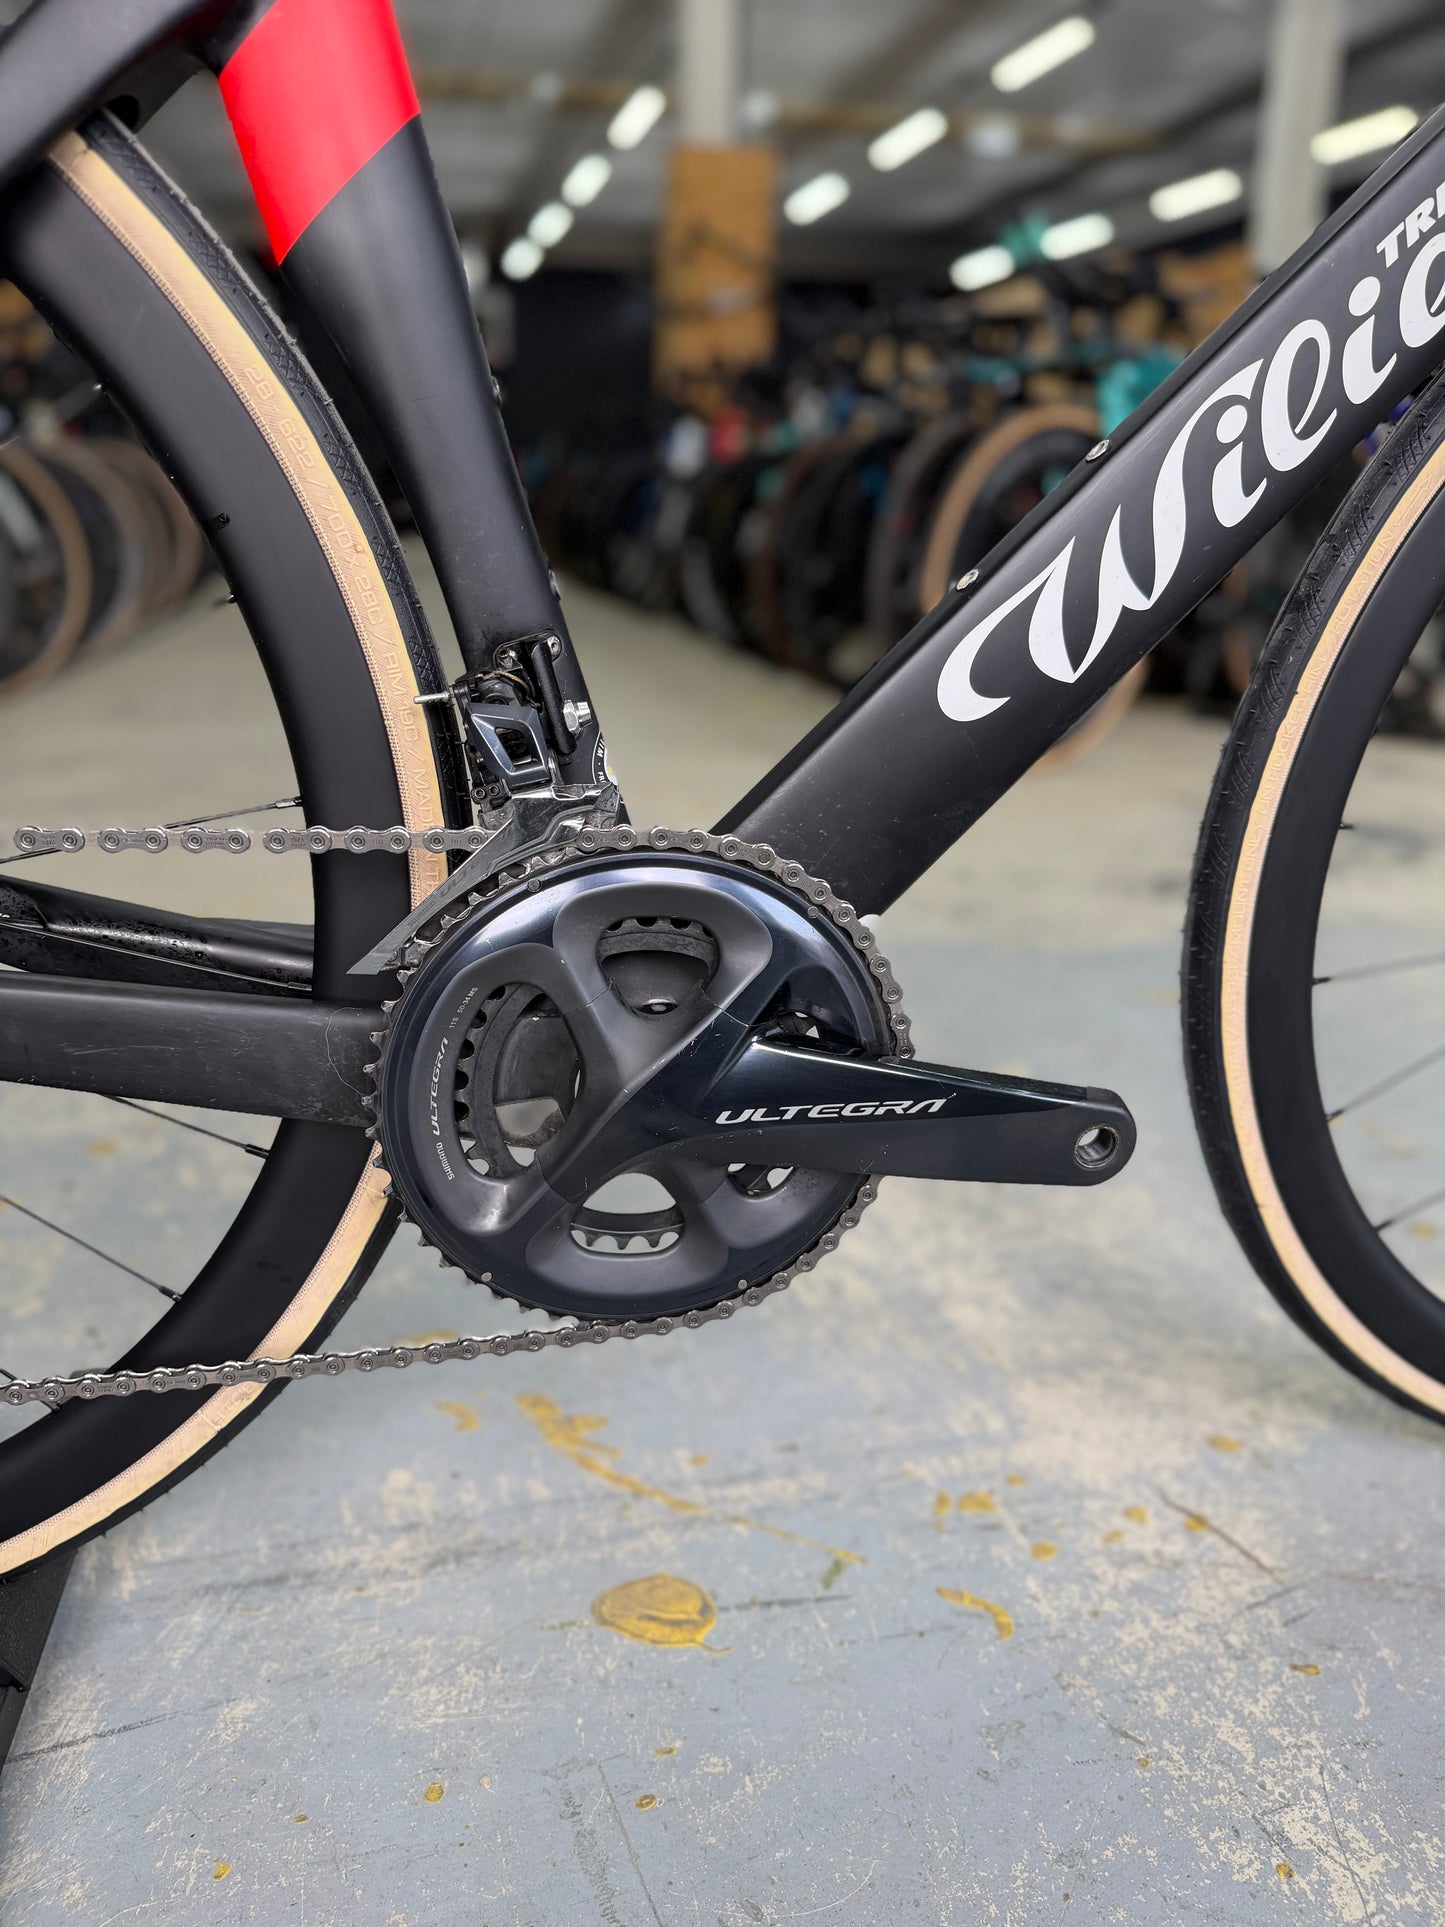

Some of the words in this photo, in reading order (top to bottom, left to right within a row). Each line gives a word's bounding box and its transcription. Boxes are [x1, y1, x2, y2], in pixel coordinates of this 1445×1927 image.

[244, 366, 275, 400] 28
[279, 418, 315, 470] 622
[320, 495, 354, 550] 700
[383, 651, 408, 696] RIM
[1331, 532, 1396, 636] ROTATION
[1230, 880, 1250, 946] MOUNT
[1245, 822, 1263, 873] ONLY
[1258, 785, 1275, 815] ON
[1303, 656, 1326, 695] RIM
[456, 996, 471, 1014] 50-34
[467, 986, 479, 998] MS
[448, 1017, 460, 1029] 11S
[430, 1036, 449, 1137] ULTEGRA
[715, 1098, 947, 1125] ULTEGRA
[435, 1141, 456, 1181] SHIMANO
